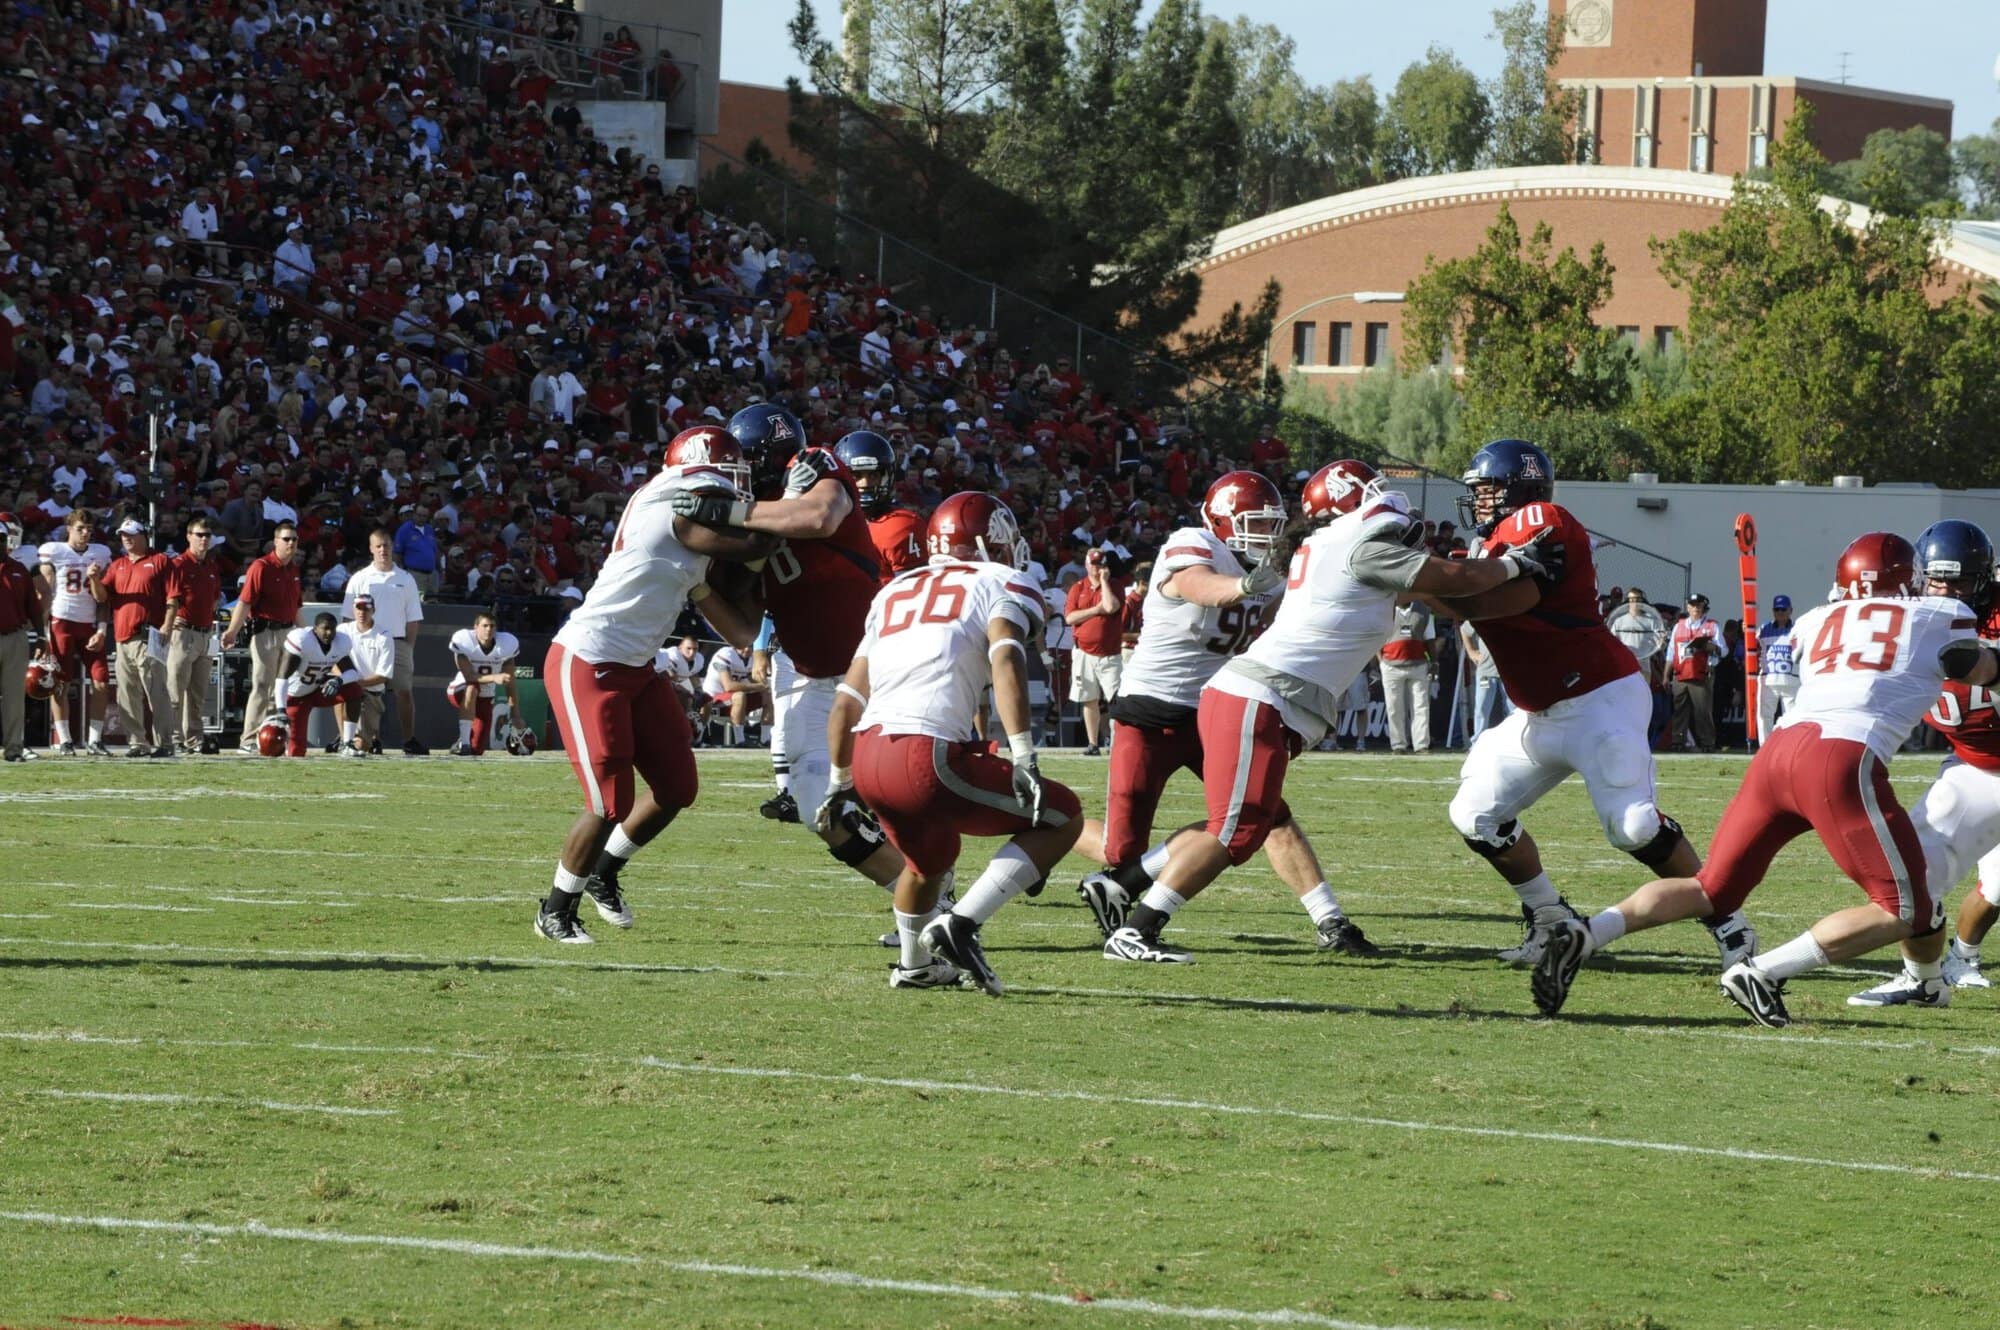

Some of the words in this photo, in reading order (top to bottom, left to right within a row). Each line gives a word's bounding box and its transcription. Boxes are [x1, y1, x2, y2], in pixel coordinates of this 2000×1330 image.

[768, 414, 795, 441] A
[1521, 454, 1545, 480] A
[1511, 504, 1545, 532] 70
[909, 531, 921, 558] 4
[930, 534, 950, 554] 26
[878, 564, 979, 638] 26
[1809, 603, 1906, 675] 43
[1767, 661, 1792, 673] 10
